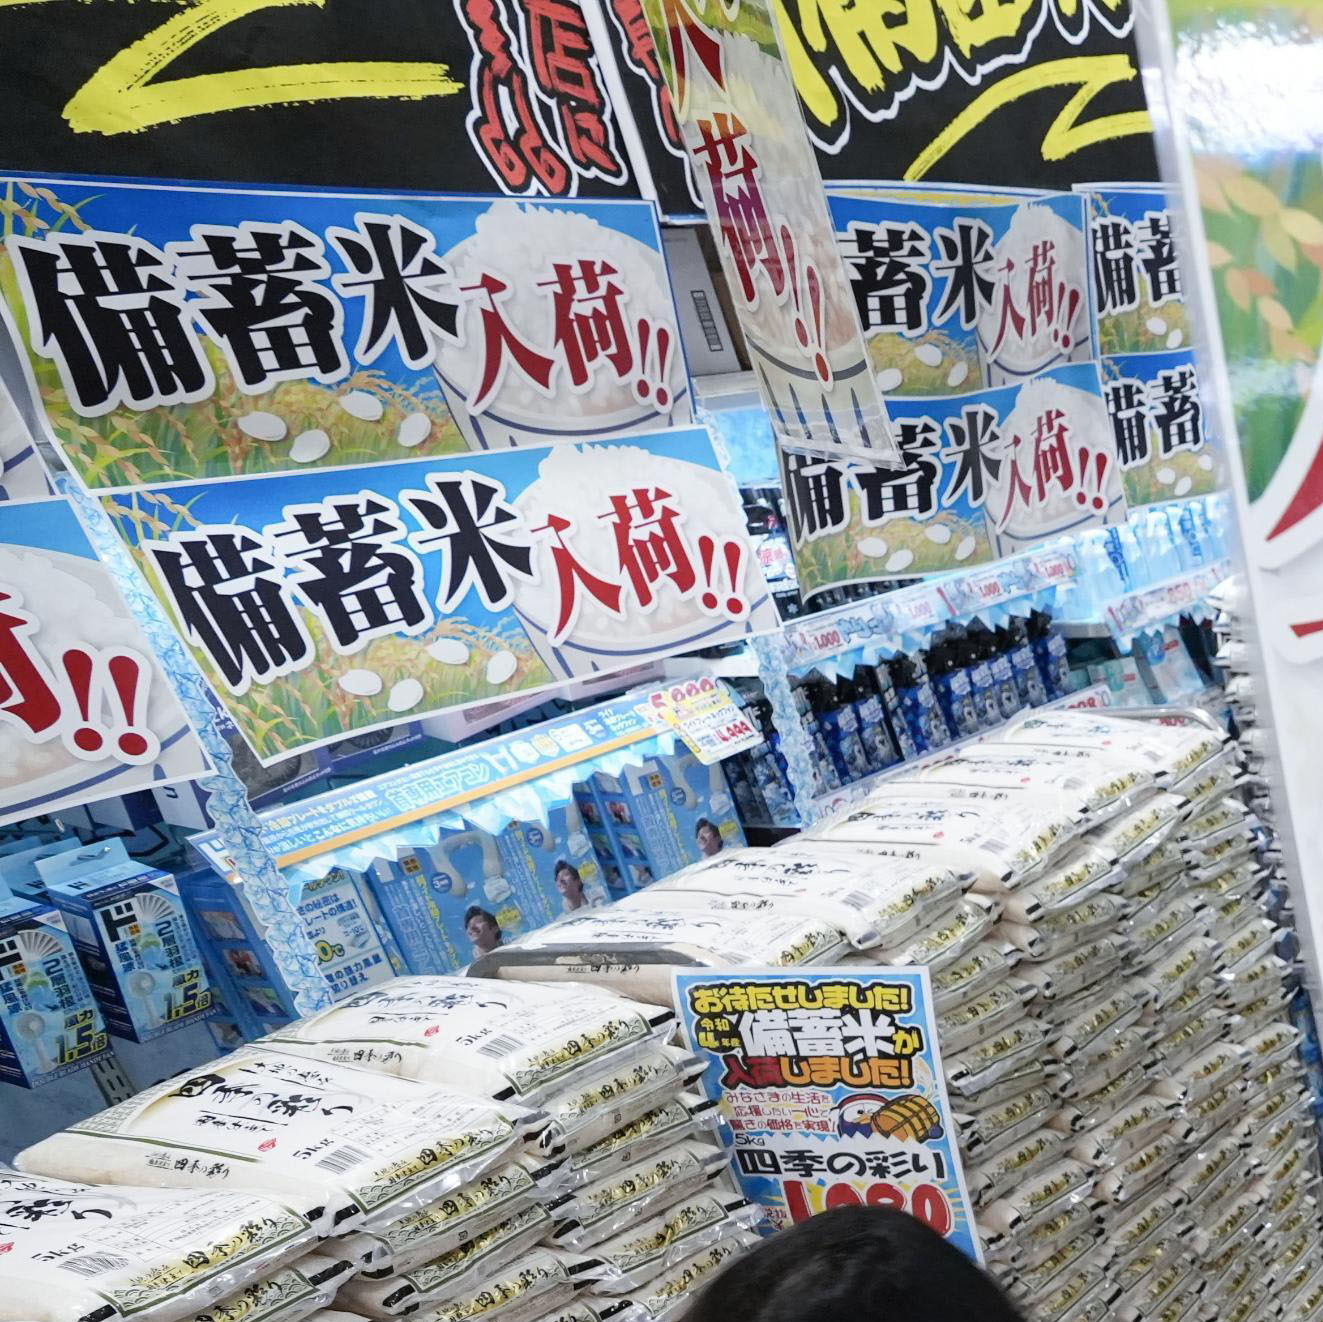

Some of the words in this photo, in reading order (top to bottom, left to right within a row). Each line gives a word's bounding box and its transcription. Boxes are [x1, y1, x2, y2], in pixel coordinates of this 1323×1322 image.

[843, 217, 1080, 355] 蓄米入荷!!
[693, 986, 911, 1014] お待たせしました!
[735, 1134, 765, 1146] 5kg
[741, 1151, 945, 1179] 四季の彩り
